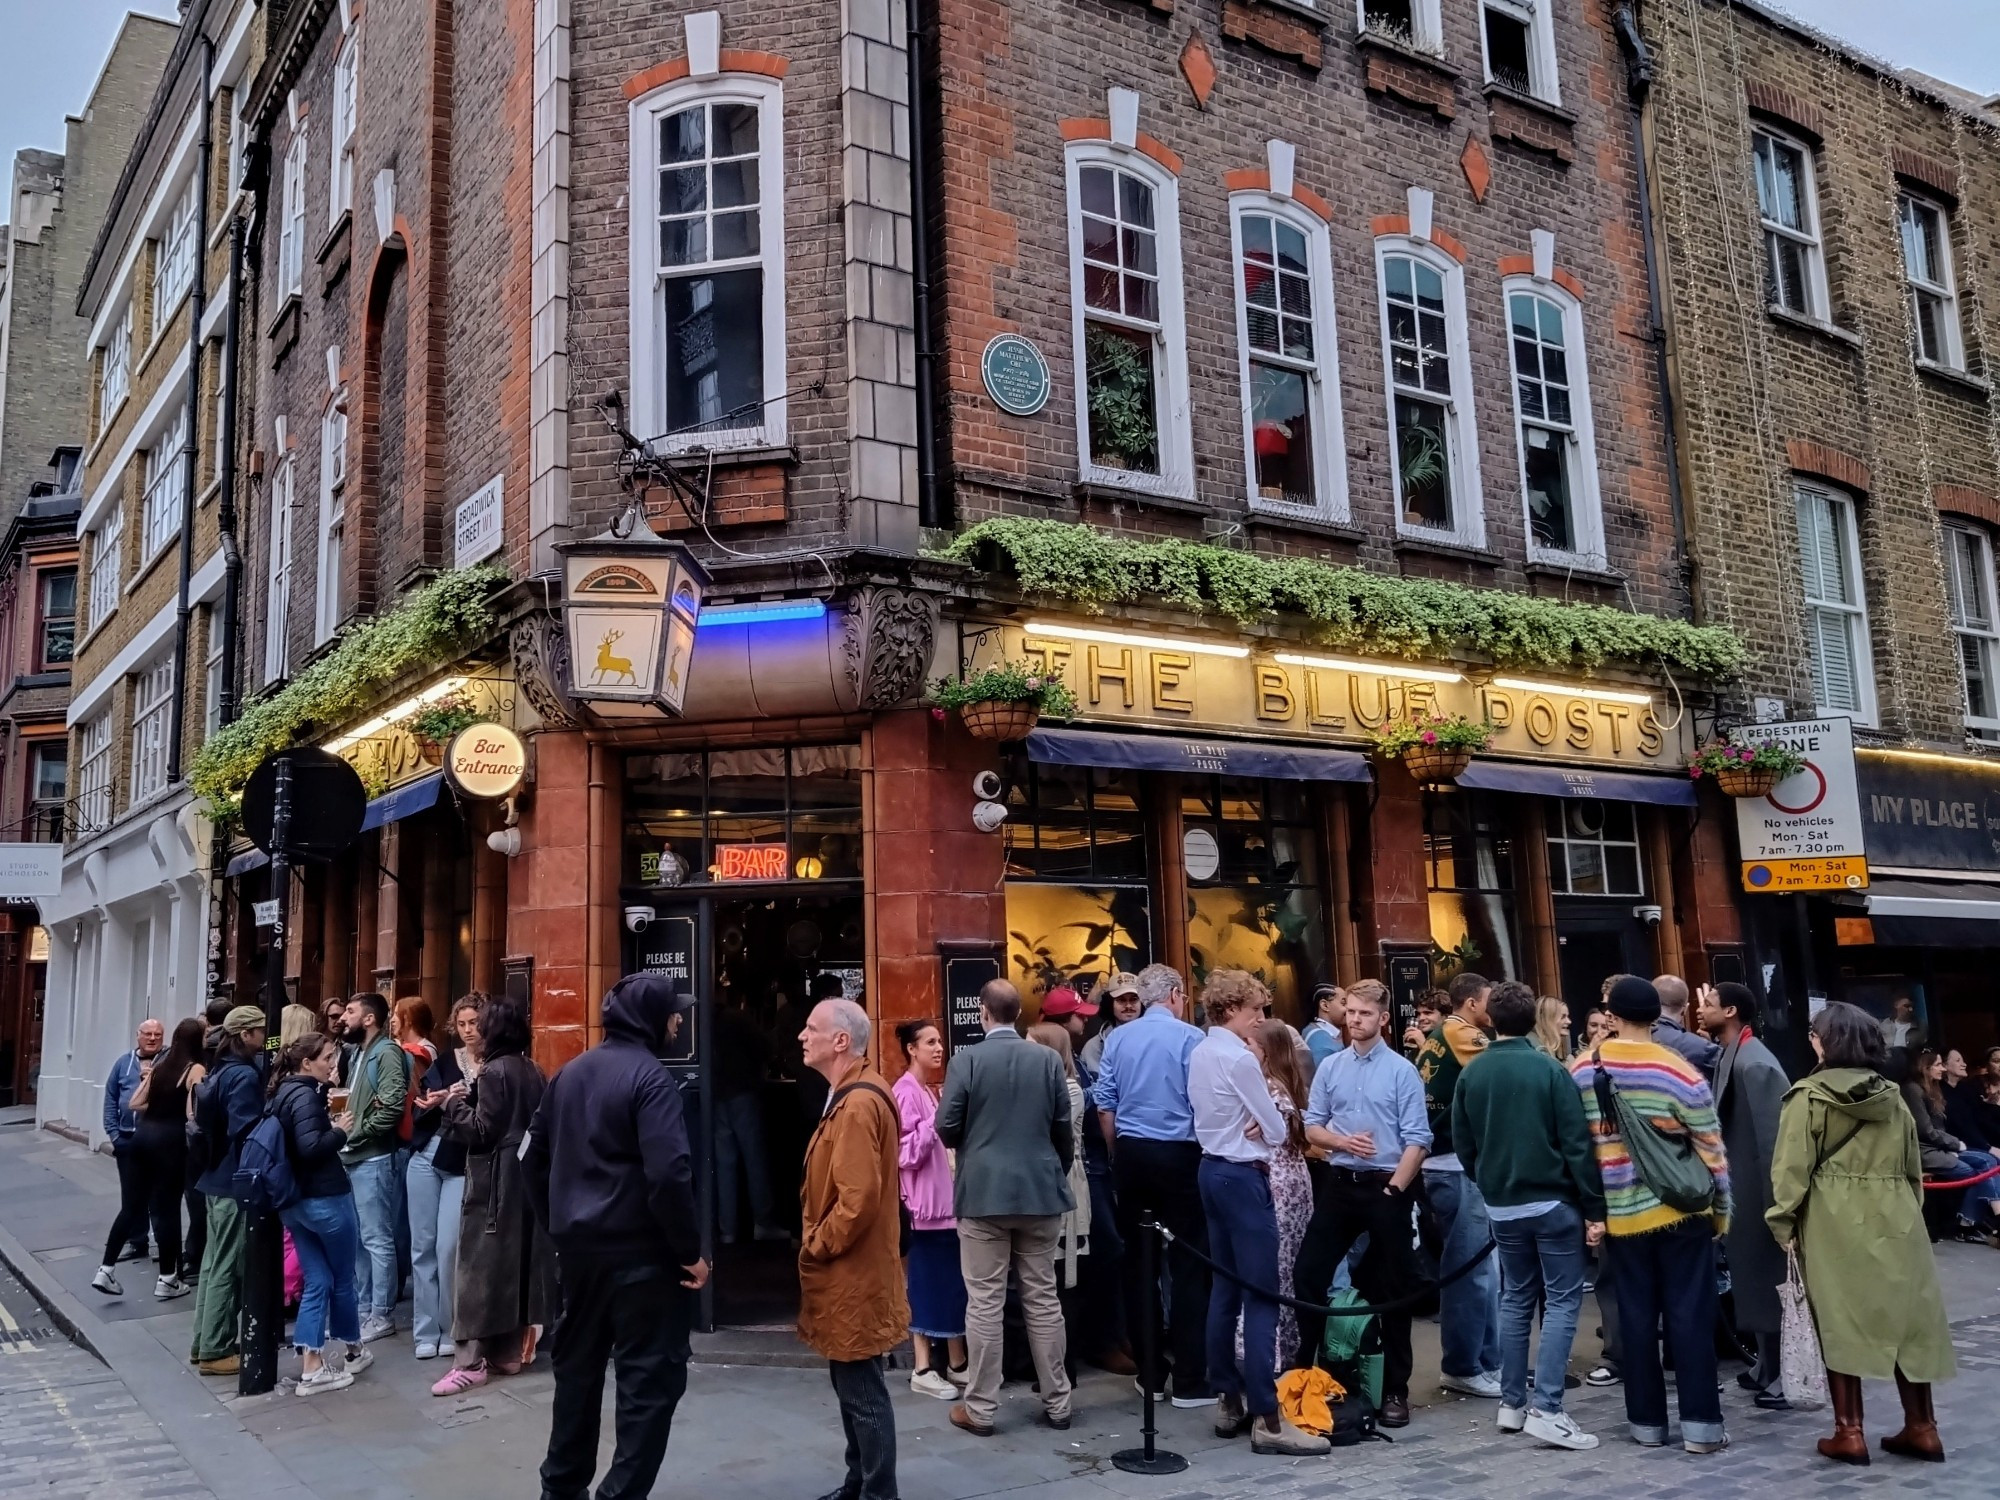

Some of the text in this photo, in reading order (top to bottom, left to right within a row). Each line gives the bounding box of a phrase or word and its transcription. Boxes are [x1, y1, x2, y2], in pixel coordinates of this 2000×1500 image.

[999, 351, 1033, 364] MATTHEWS
[458, 486, 496, 530] BROADWICK
[458, 512, 493, 551] STREET W1
[1022, 637, 1664, 757] THE BLUE POSTS
[1748, 723, 1831, 739] PEDESTRIAN
[473, 739, 506, 754] Bar
[1185, 744, 1227, 757] THE BLUE
[455, 756, 523, 775] Entrance
[1870, 793, 1979, 830] MY PLACE
[1764, 816, 1835, 829] No vehicles
[1772, 832, 1798, 842] Mon
[1808, 830, 1829, 840] Sat
[1795, 843, 1823, 854] 7.30
[1826, 844, 1845, 853] pm
[722, 848, 787, 877] BAR
[1790, 862, 1816, 872] Mon
[1825, 861, 1847, 871] Sat
[1812, 874, 1841, 884] 7.30
[273, 921, 284, 934] S
[273, 937, 283, 950] 4
[646, 952, 685, 965] PLEASE BE
[1409, 989, 1415, 1001] A
[956, 996, 981, 1009] PLEASE
